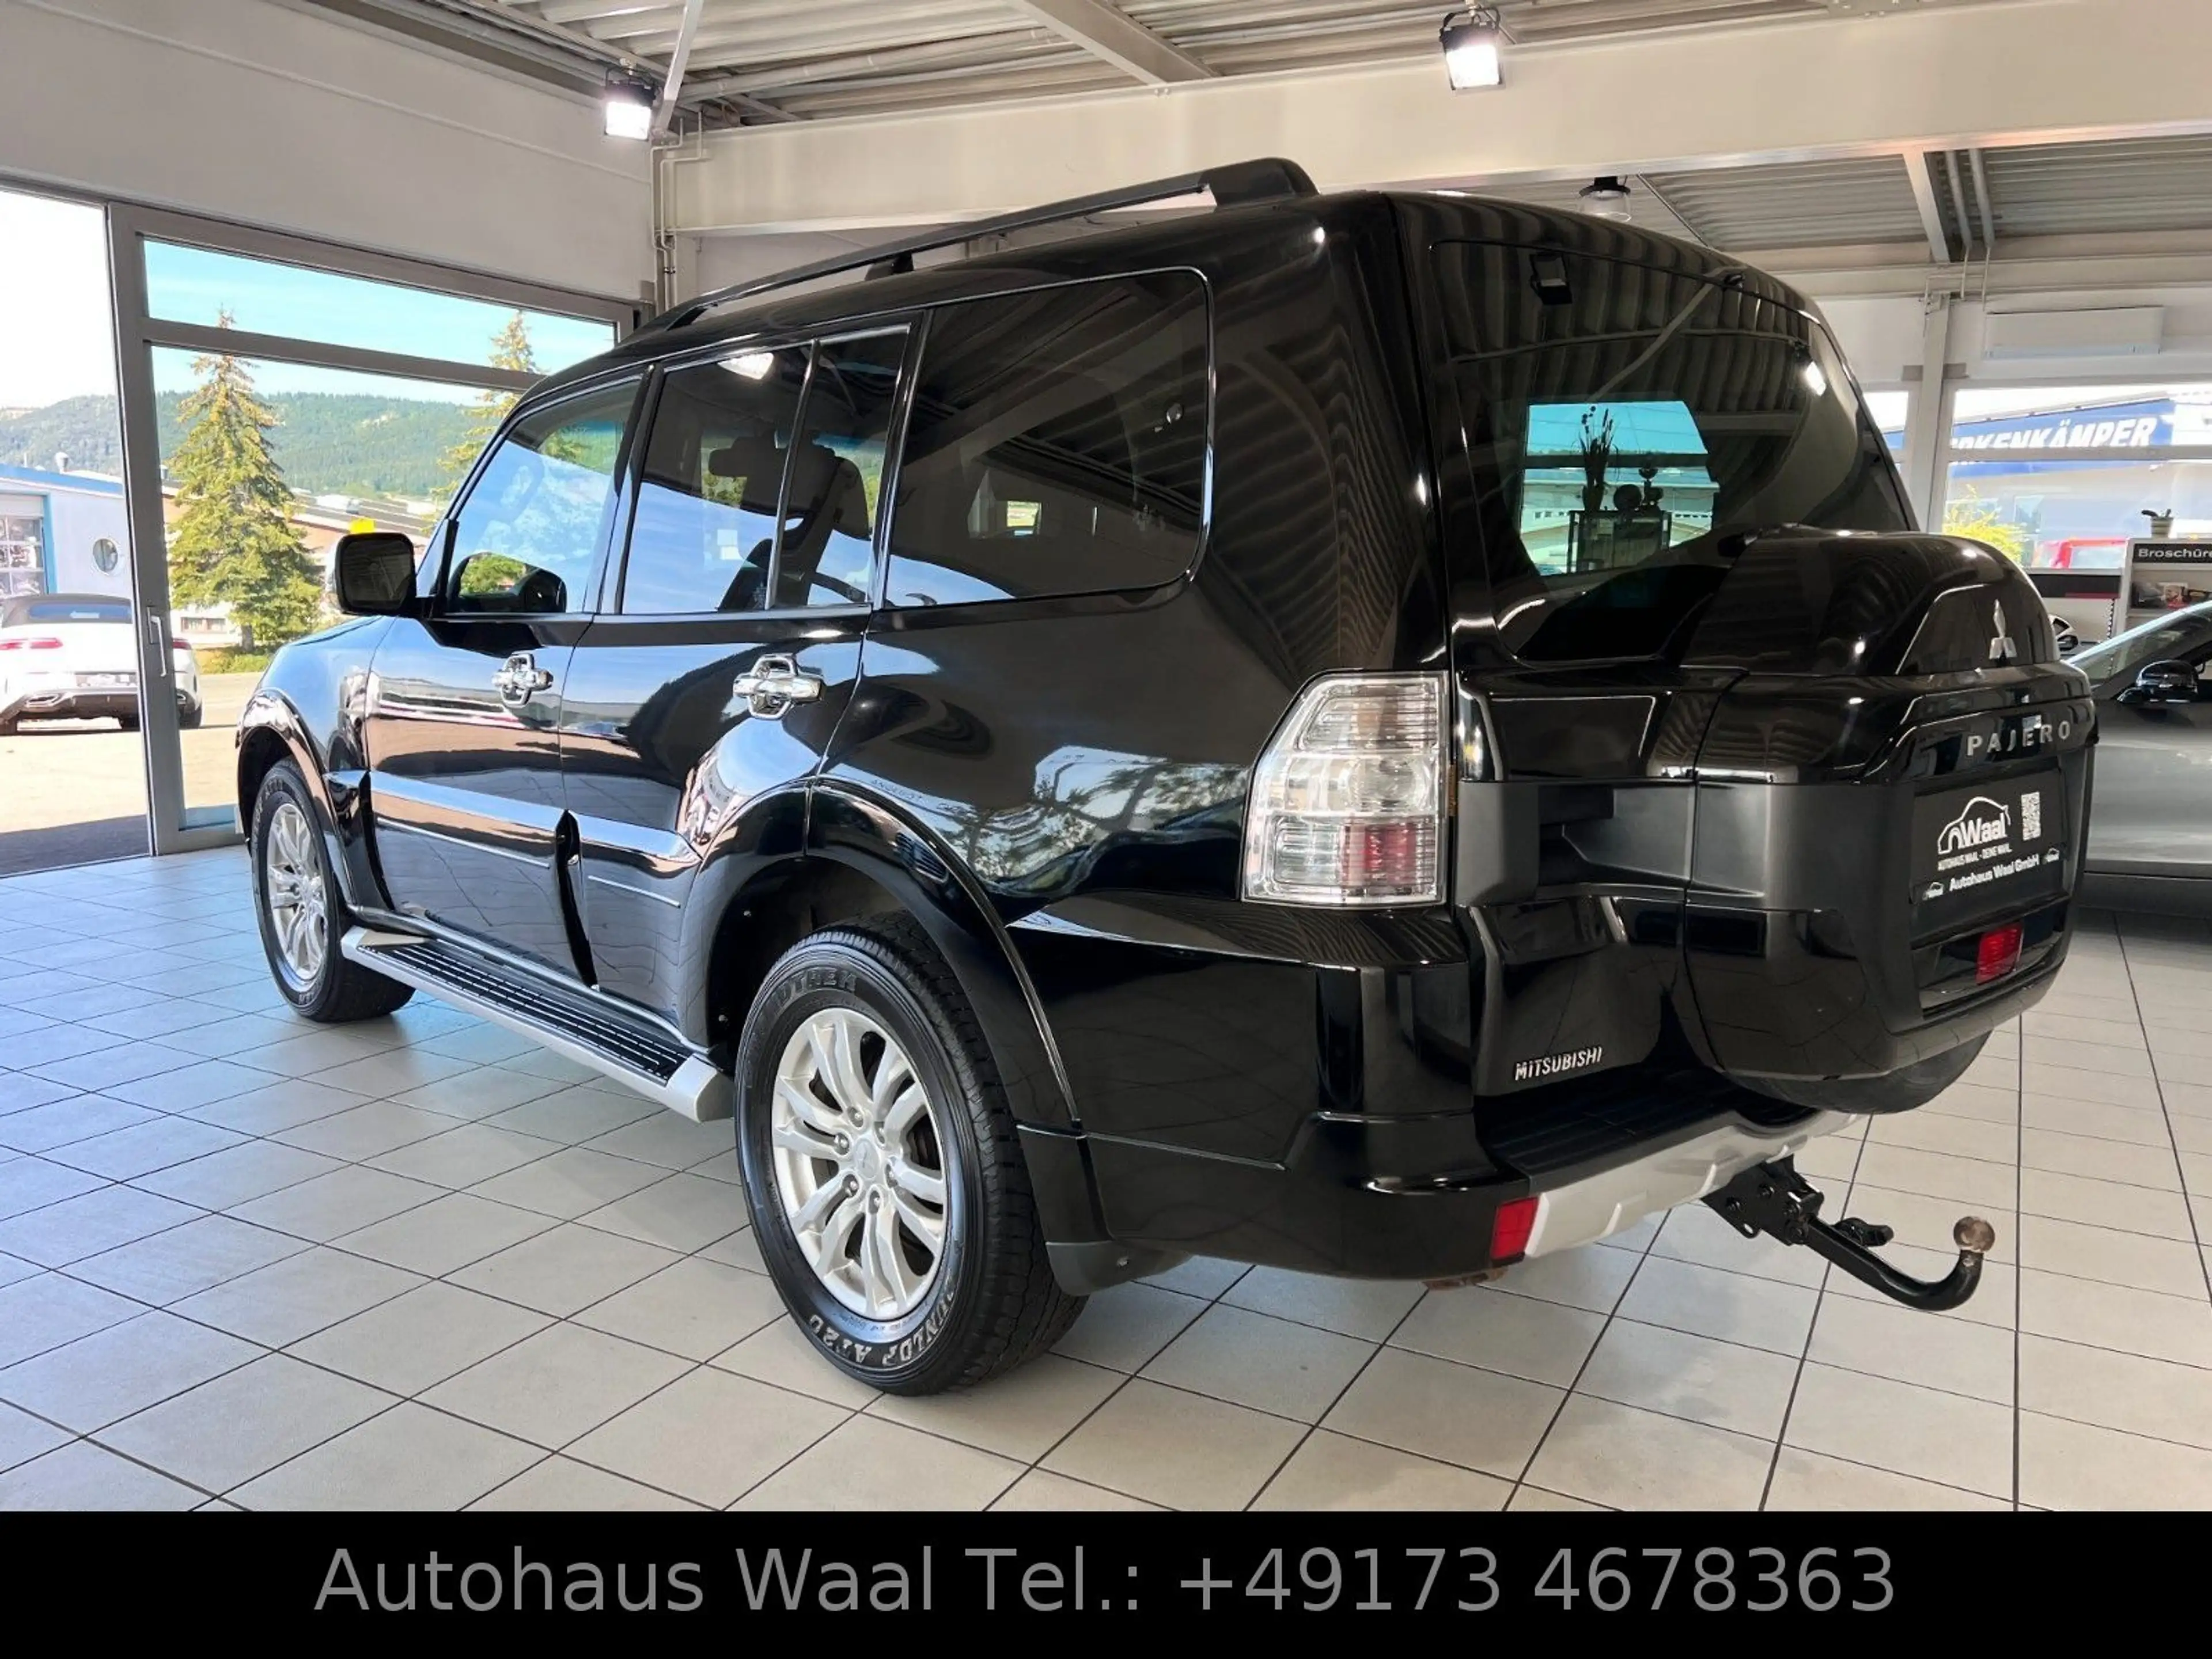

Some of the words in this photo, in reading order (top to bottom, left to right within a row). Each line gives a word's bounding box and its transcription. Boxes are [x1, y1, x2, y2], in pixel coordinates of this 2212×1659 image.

[1966, 720, 2071, 757] PAJERO
[1960, 812, 2008, 849] Waal
[1949, 872, 1994, 892] Autohaus
[1993, 861, 2016, 878] Waal
[2016, 854, 2040, 872] GmbH
[1514, 1046, 1604, 1081] MITSUBISHI
